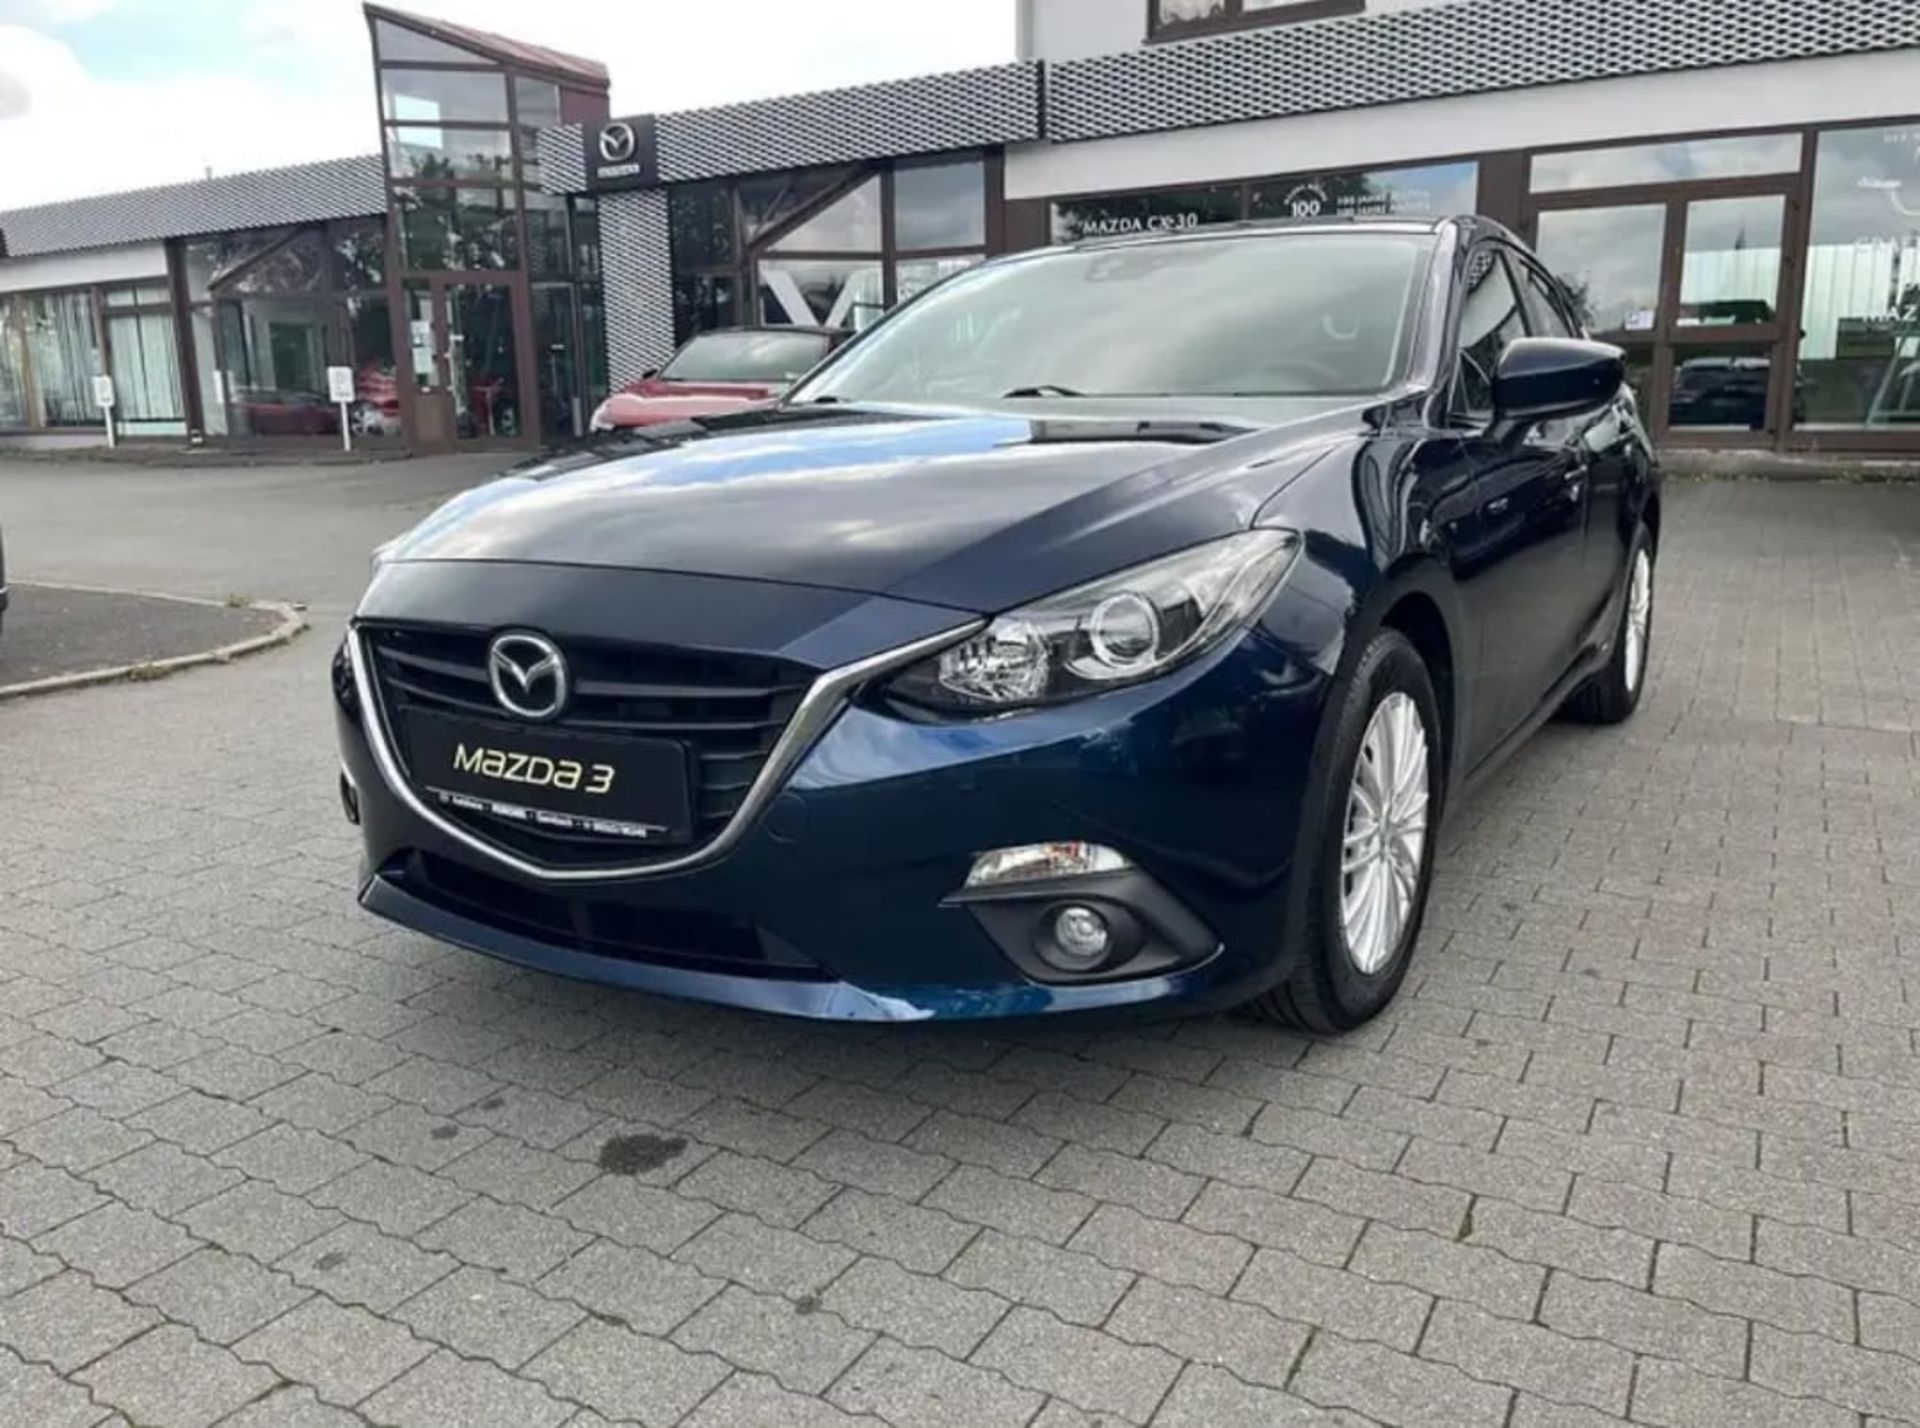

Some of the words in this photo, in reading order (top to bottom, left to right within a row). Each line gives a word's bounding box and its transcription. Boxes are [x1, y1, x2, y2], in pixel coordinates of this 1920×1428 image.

[1291, 200, 1320, 217] 100
[1082, 217, 1142, 234] MAZDA
[584, 763, 615, 793] 3
